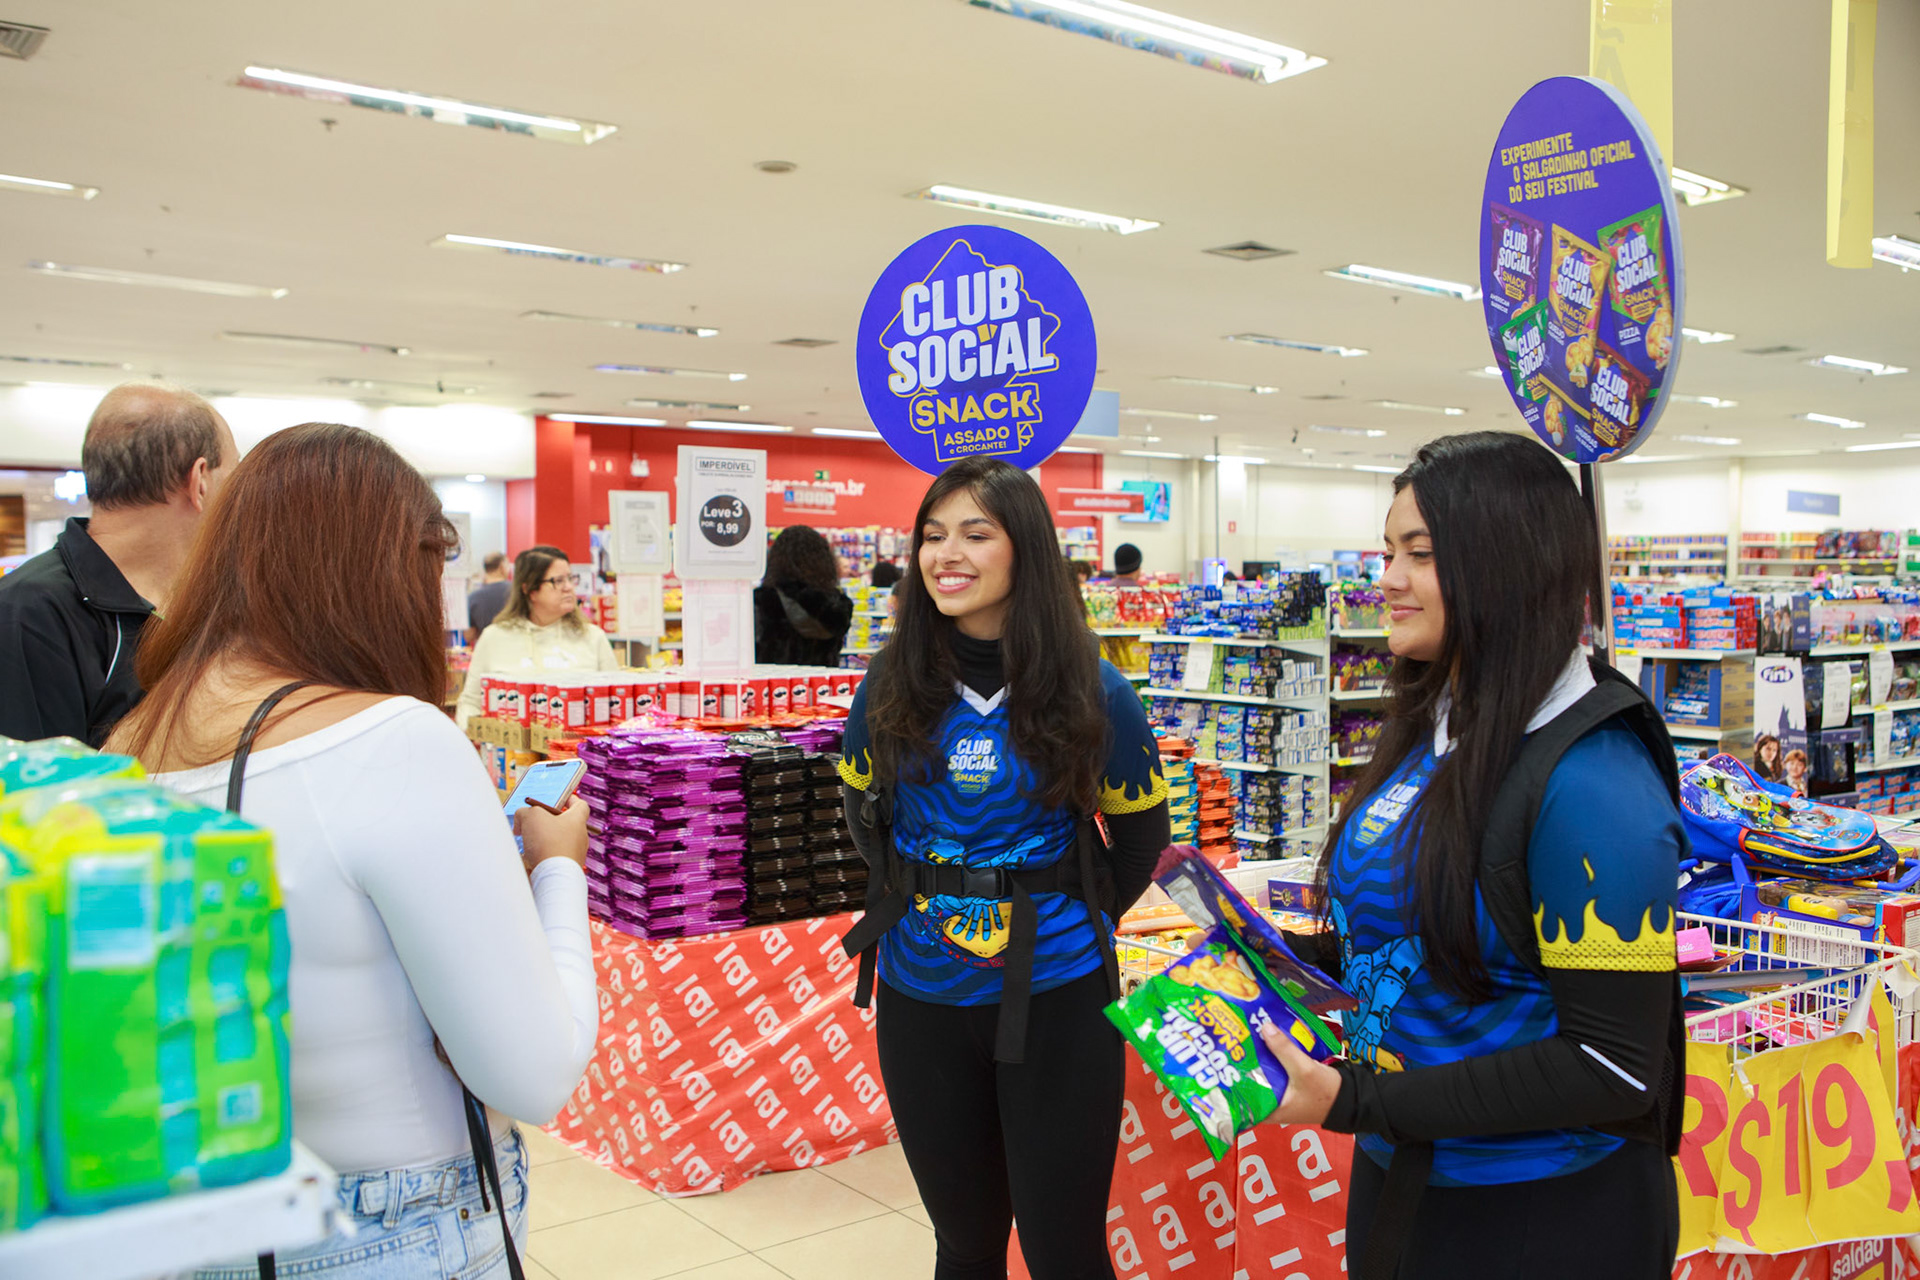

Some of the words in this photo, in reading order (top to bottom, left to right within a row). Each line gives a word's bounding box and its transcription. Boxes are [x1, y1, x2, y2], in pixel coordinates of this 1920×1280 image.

[1501, 132, 1574, 166] EXPERIMENTE
[1513, 166, 1520, 183] O
[1522, 150, 1588, 181] SALGADINHO
[1590, 140, 1635, 167] OFICIAL
[1509, 185, 1523, 203] DO
[1525, 181, 1545, 201] SEU
[1547, 170, 1599, 196] FESTIVAL
[1503, 228, 1528, 253] CLUB
[1618, 234, 1648, 268] CLUB
[1502, 271, 1527, 291] SNACK
[1561, 255, 1590, 285] CLUB
[902, 266, 1020, 336] CLUB
[1625, 286, 1655, 307] SNACK
[1559, 299, 1588, 324] SNACK
[1517, 325, 1541, 358] CLUB
[1618, 326, 1641, 340] PIZZA
[1597, 366, 1628, 400] CLUB
[915, 390, 1036, 427] SNACK
[944, 426, 1010, 446] ASSADO
[1591, 408, 1621, 438] SNACK
[956, 441, 1007, 453] CROCANTE!
[703, 506, 731, 518] Leve
[732, 500, 743, 518] 3
[716, 523, 739, 535] 8,99
[956, 739, 994, 755] CLUB
[954, 773, 990, 784] SNACK
[1385, 783, 1420, 803] CLUB
[1187, 997, 1246, 1062] SNACK
[1156, 1024, 1220, 1090] CLUB
